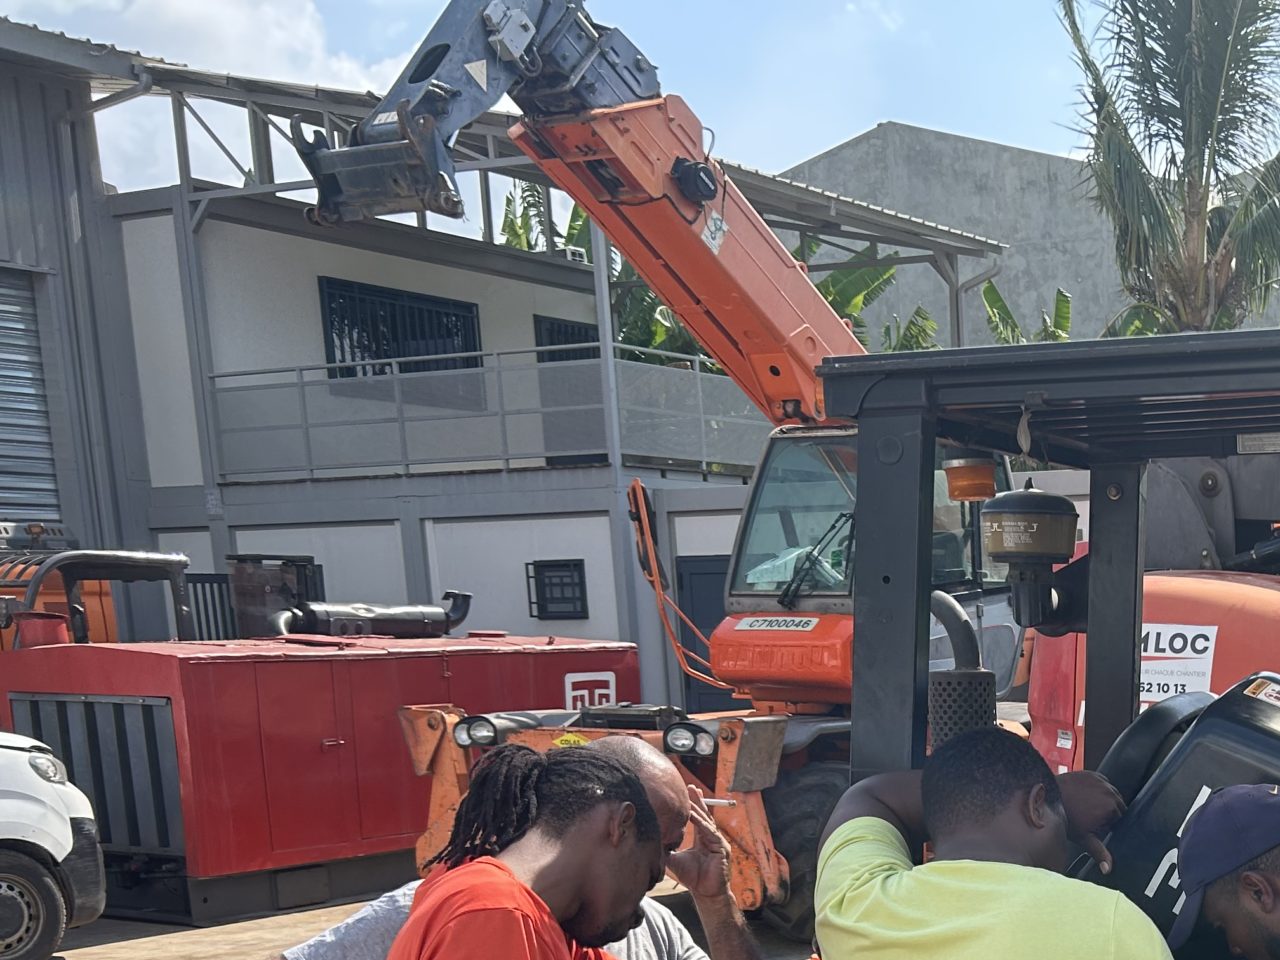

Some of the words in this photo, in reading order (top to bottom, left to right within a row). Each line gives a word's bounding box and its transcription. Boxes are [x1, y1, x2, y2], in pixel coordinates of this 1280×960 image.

[749, 618, 812, 629] C7100046
[1140, 682, 1153, 693] 62
[1156, 682, 1170, 694] 10
[1174, 683, 1187, 694] 13
